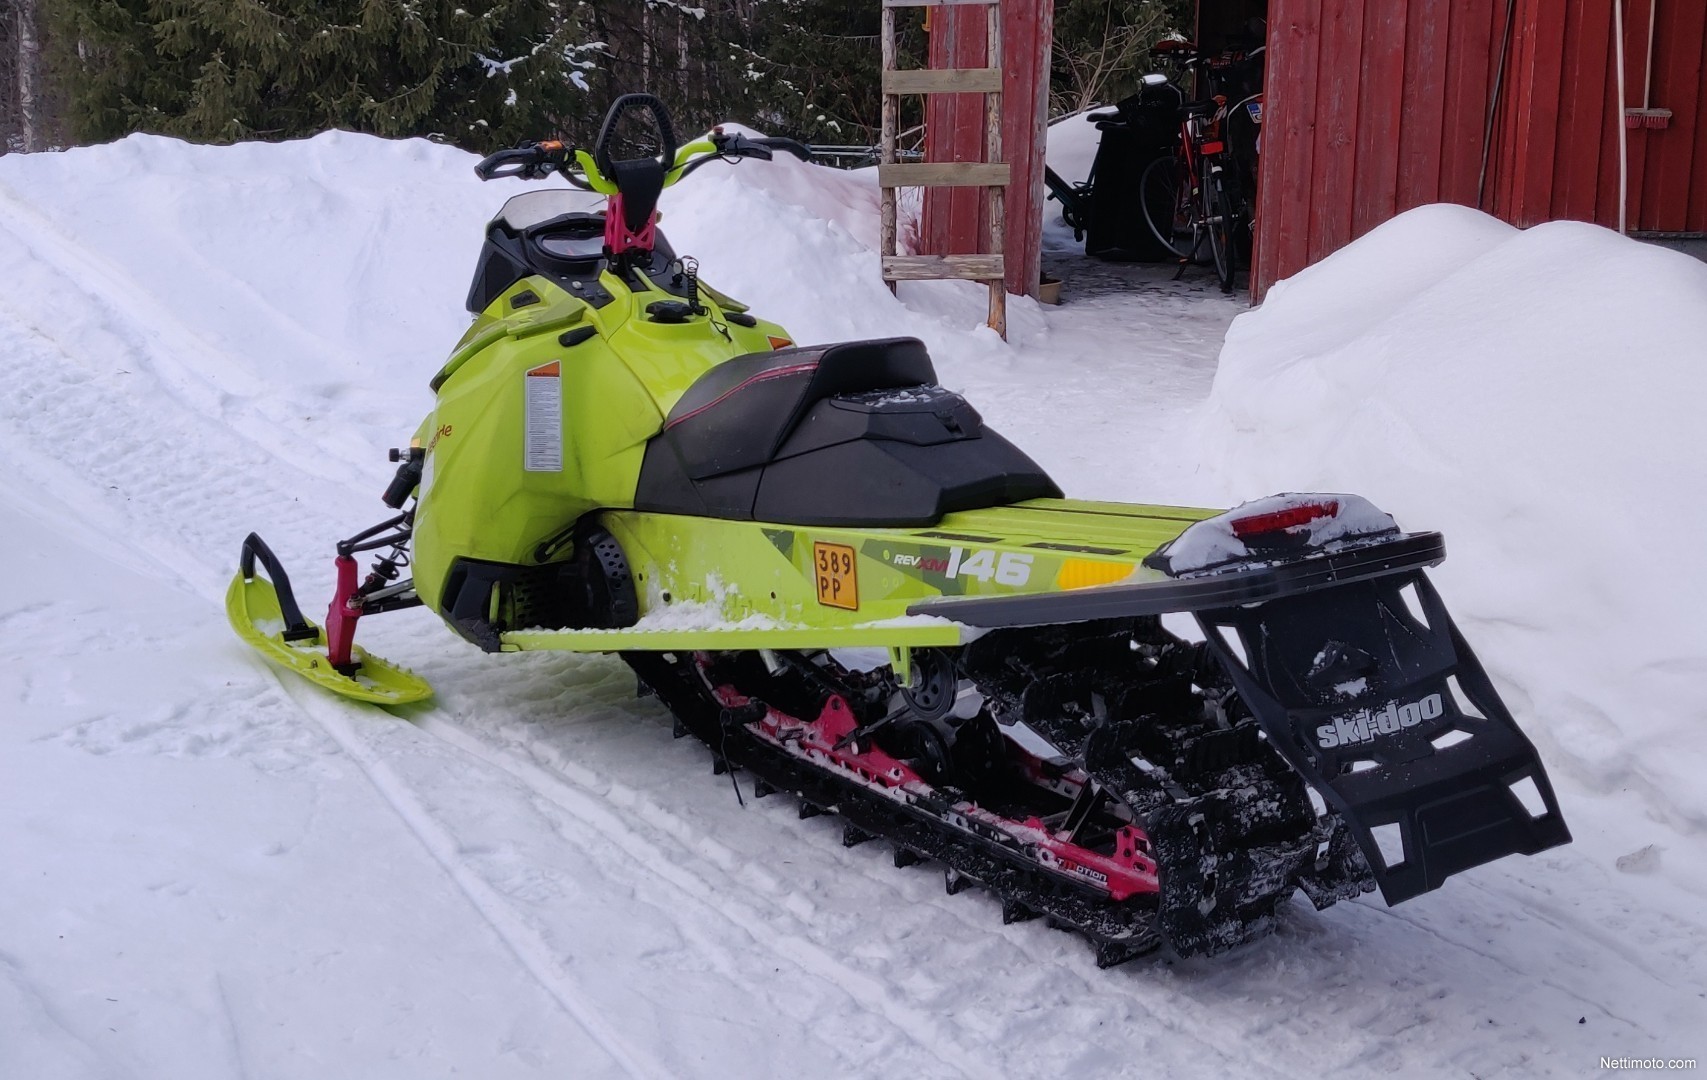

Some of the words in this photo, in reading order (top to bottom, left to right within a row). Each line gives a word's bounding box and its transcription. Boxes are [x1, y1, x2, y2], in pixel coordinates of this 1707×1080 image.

[819, 549, 850, 575] 389
[945, 546, 1034, 587] 146
[821, 576, 840, 600] PP
